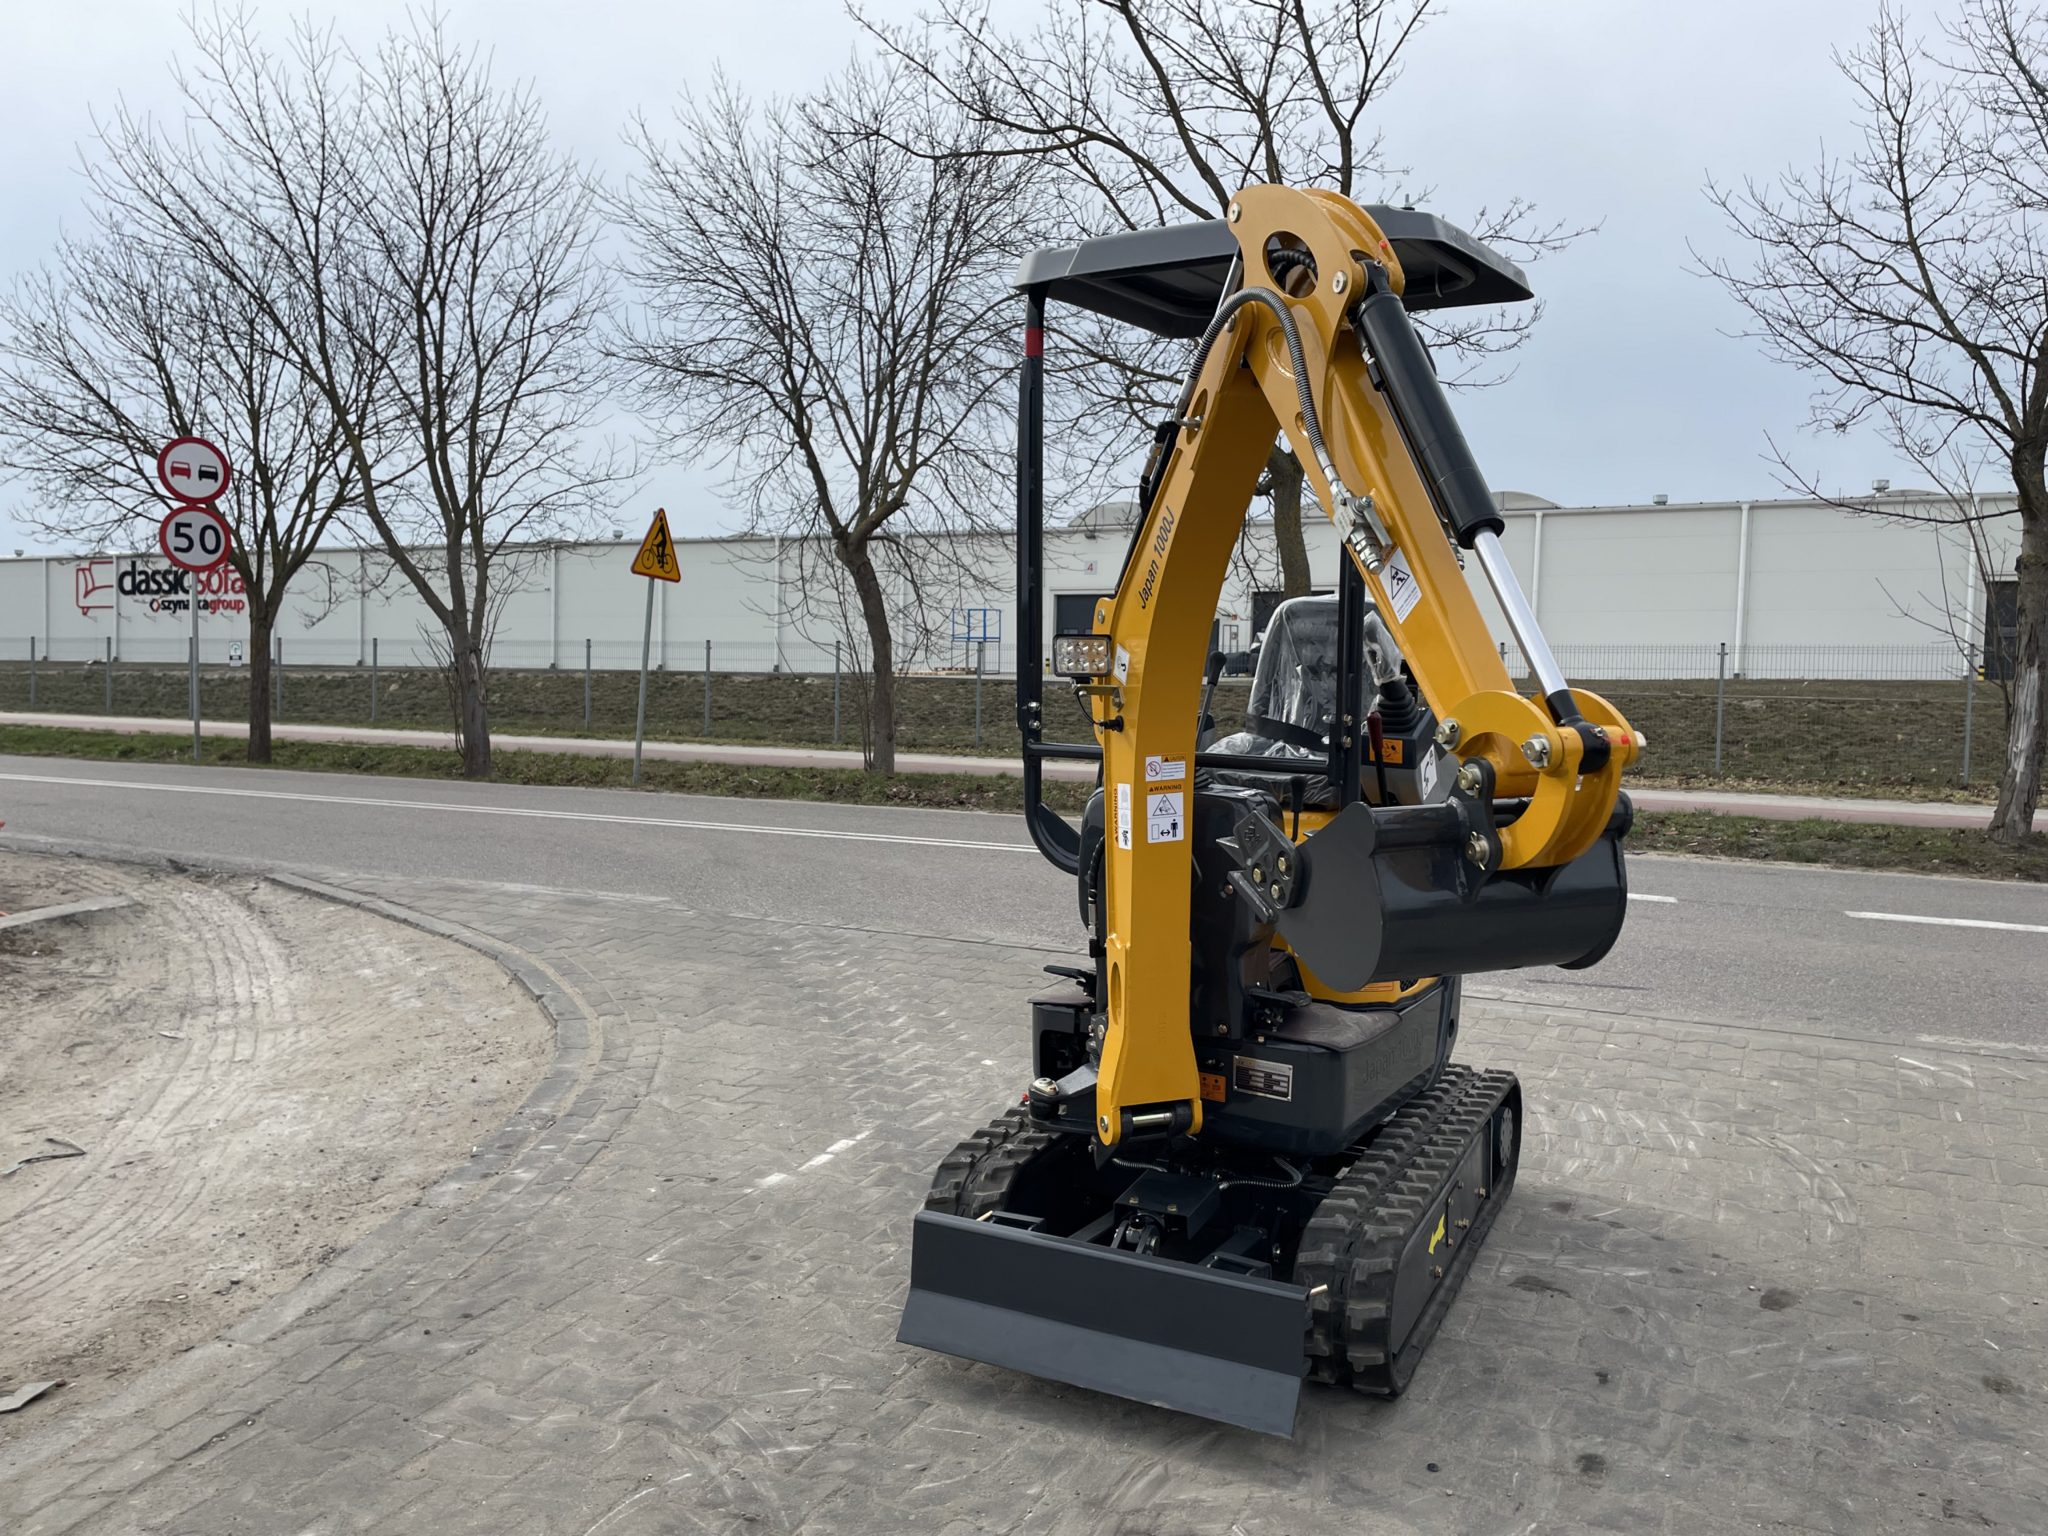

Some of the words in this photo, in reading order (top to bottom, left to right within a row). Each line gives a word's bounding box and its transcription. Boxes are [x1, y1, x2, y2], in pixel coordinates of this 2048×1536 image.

[173, 522, 221, 555] 50
[1086, 562, 1094, 572] 4
[1138, 559, 1159, 609] Japan
[1153, 505, 1175, 559] 1000J
[1154, 783, 1182, 791] WARNING
[1362, 1050, 1395, 1085] Japan
